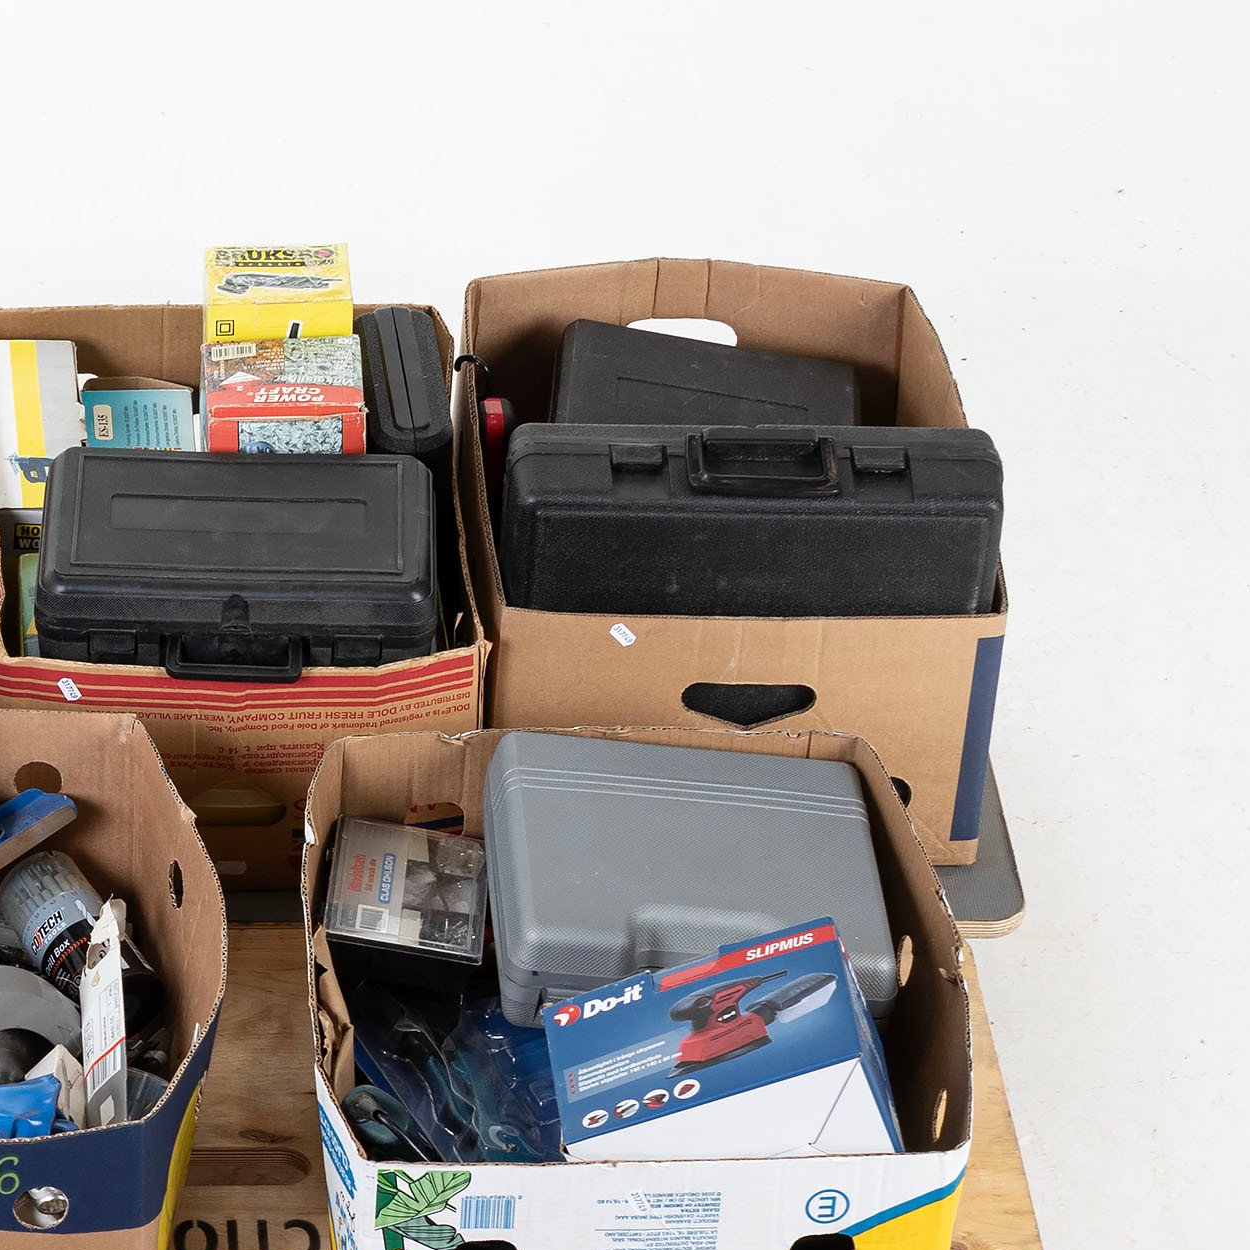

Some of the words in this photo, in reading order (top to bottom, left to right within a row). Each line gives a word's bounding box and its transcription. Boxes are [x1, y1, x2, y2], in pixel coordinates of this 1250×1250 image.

[254, 394, 326, 403] POWER
[413, 691, 470, 709] DISTRIBUTED
[399, 703, 411, 712] BY
[174, 712, 225, 722] WESTLAKE
[228, 711, 285, 723] COMPANY,
[290, 711, 322, 720] FRUIT
[326, 711, 364, 720] FRESH
[367, 707, 397, 719] DOLE
[380, 713, 423, 726] registered
[272, 723, 294, 732] Food
[297, 723, 317, 731] Dole
[320, 722, 329, 730] of
[332, 722, 377, 731] trademark
[380, 883, 391, 901] CLAS
[54, 939, 70, 958] Box
[745, 932, 814, 961] SLIPMUS
[582, 983, 642, 1019] Do-it
